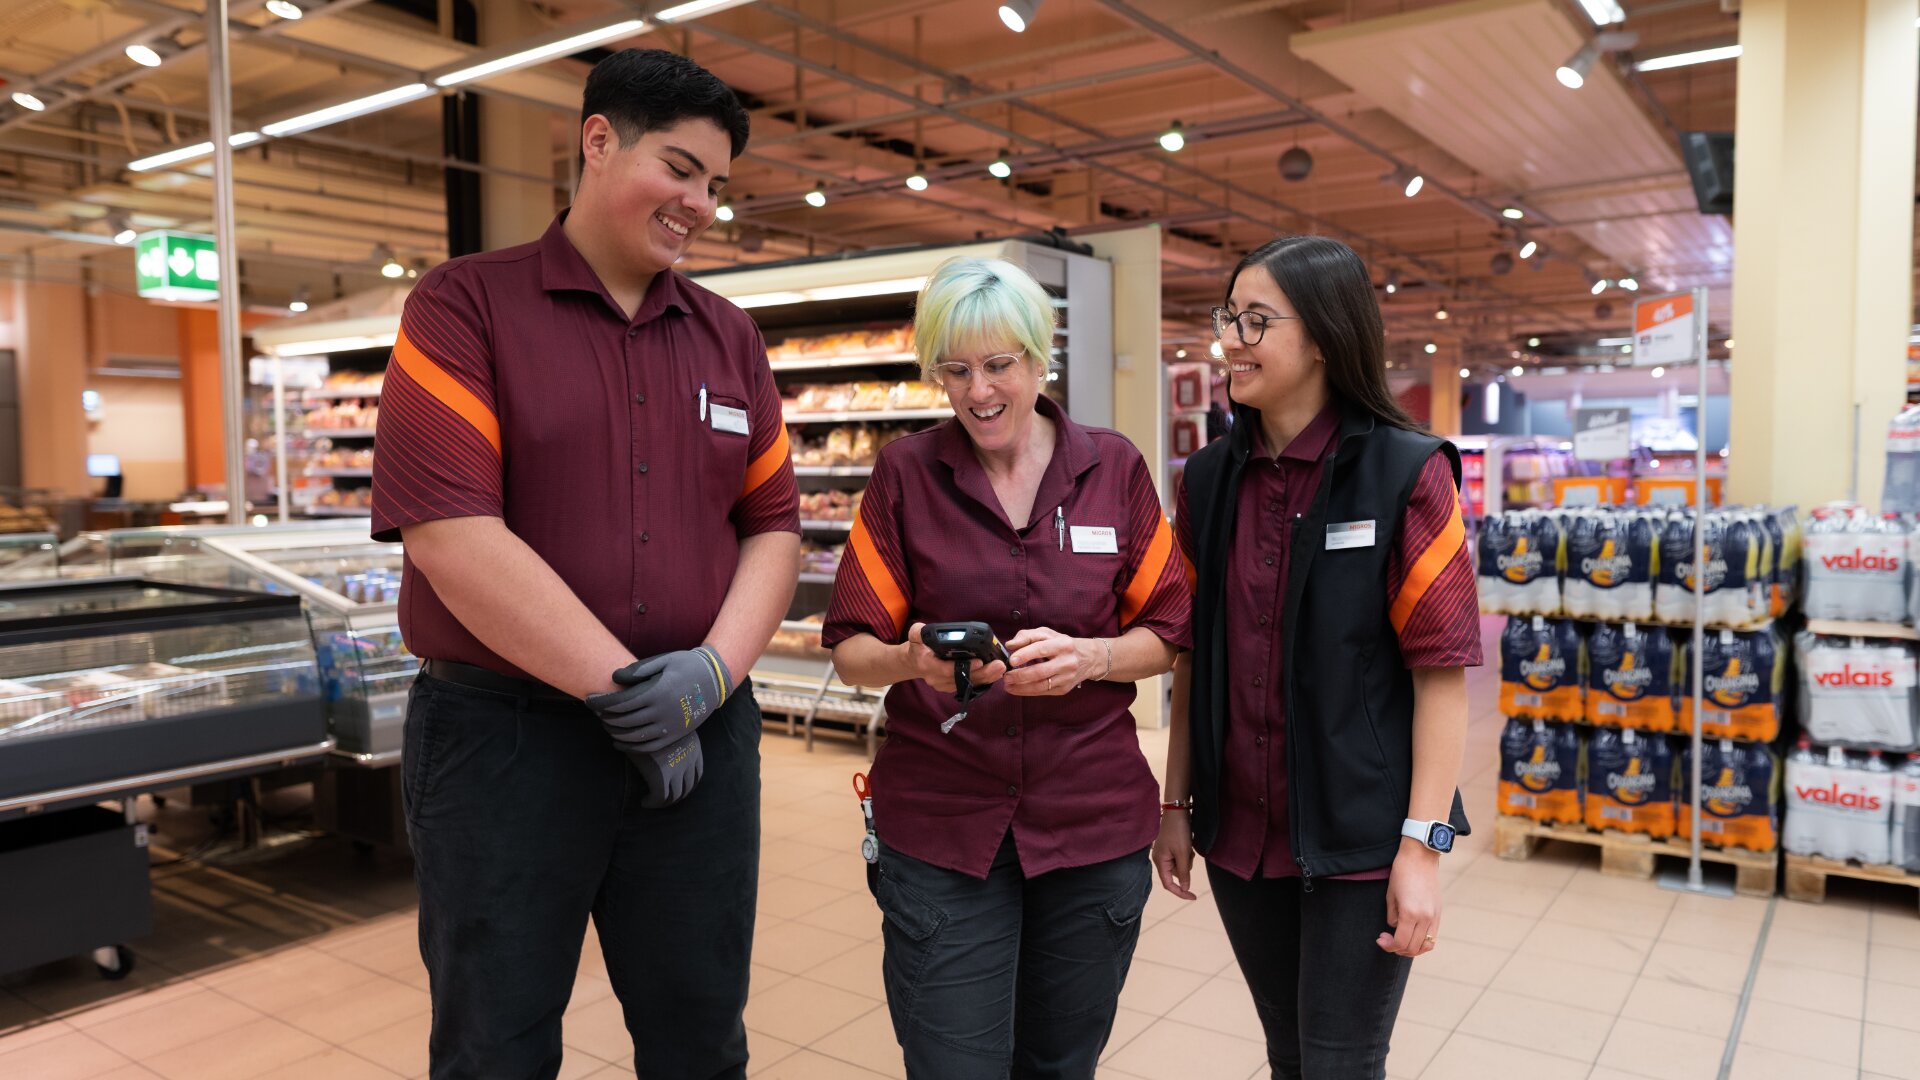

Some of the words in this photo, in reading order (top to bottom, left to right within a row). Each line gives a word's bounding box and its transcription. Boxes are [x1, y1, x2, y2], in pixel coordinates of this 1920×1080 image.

[1820, 547, 1899, 571] valais
[1814, 663, 1894, 687] valais
[1794, 783, 1882, 812] valais
